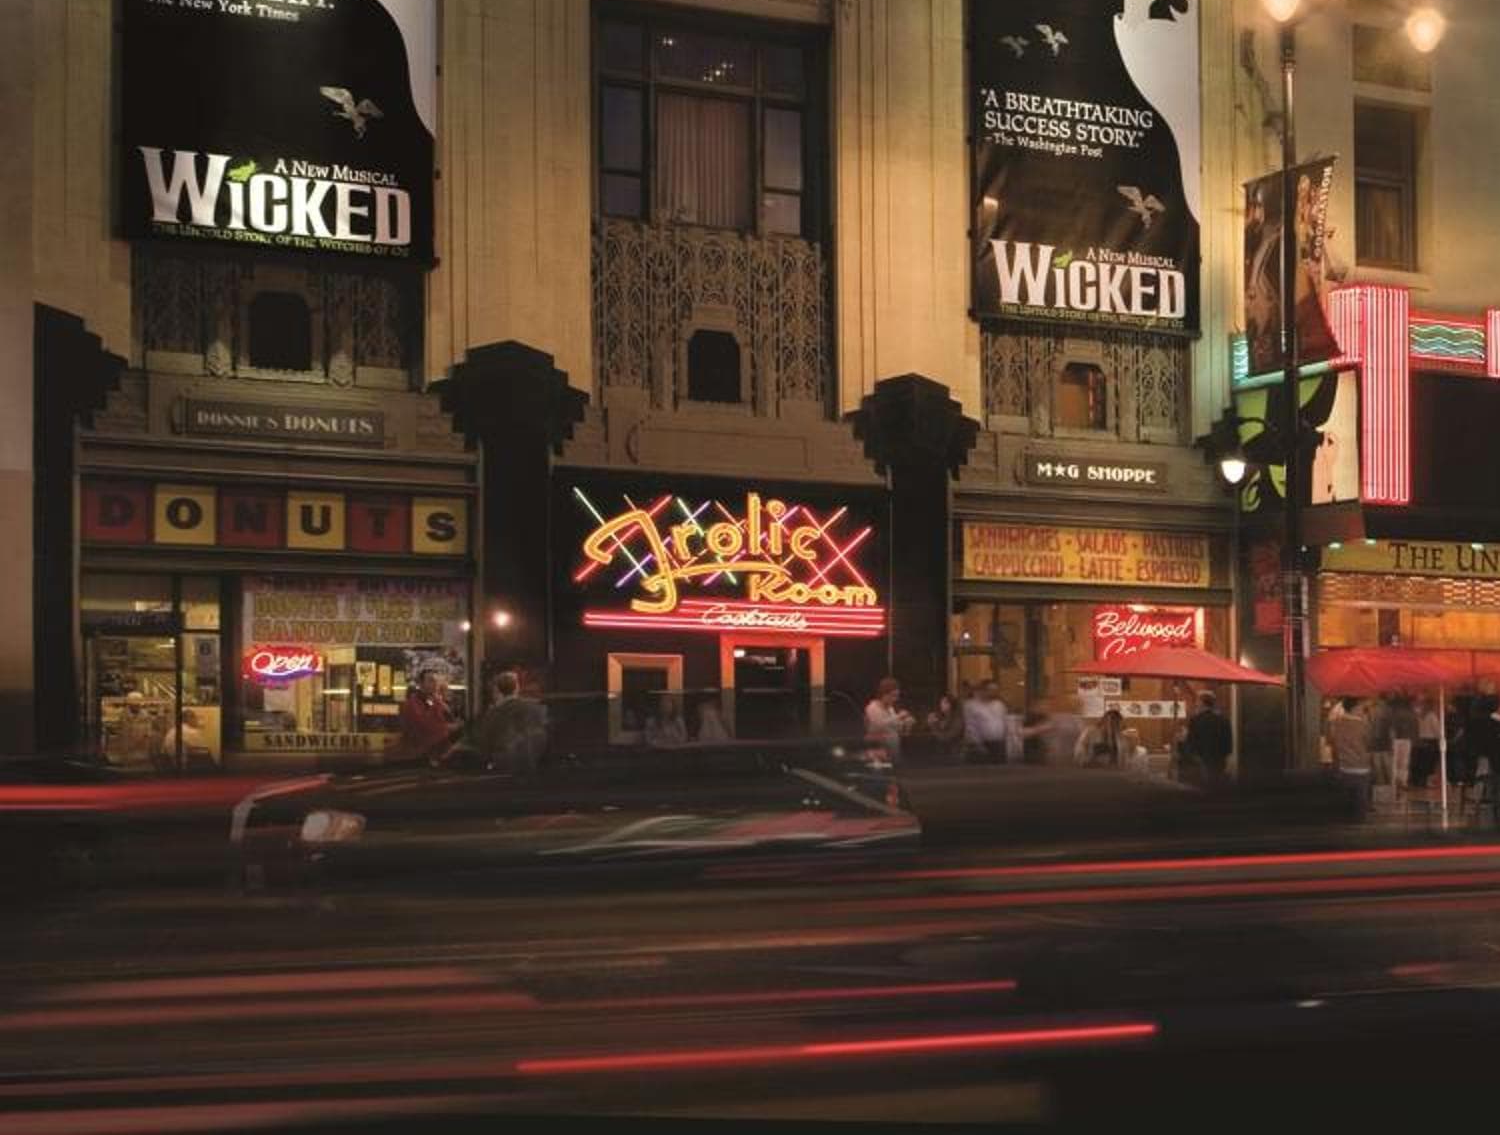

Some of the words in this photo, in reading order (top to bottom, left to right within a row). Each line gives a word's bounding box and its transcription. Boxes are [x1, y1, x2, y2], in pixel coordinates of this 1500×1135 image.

[256, 4, 299, 21] Times
[1005, 92, 1153, 129] BREATHTAKING
[984, 110, 1072, 139] SUCCESS
[1018, 135, 1078, 157] Washington
[273, 158, 289, 176] A
[284, 414, 375, 434] DONUTS
[99, 493, 458, 542] DONUTS
[584, 492, 822, 613] Frolic
[1391, 542, 1443, 571] THE
[1079, 557, 1123, 581] LATTE
[750, 573, 877, 607] Room
[263, 733, 371, 749] SANDWICHES
